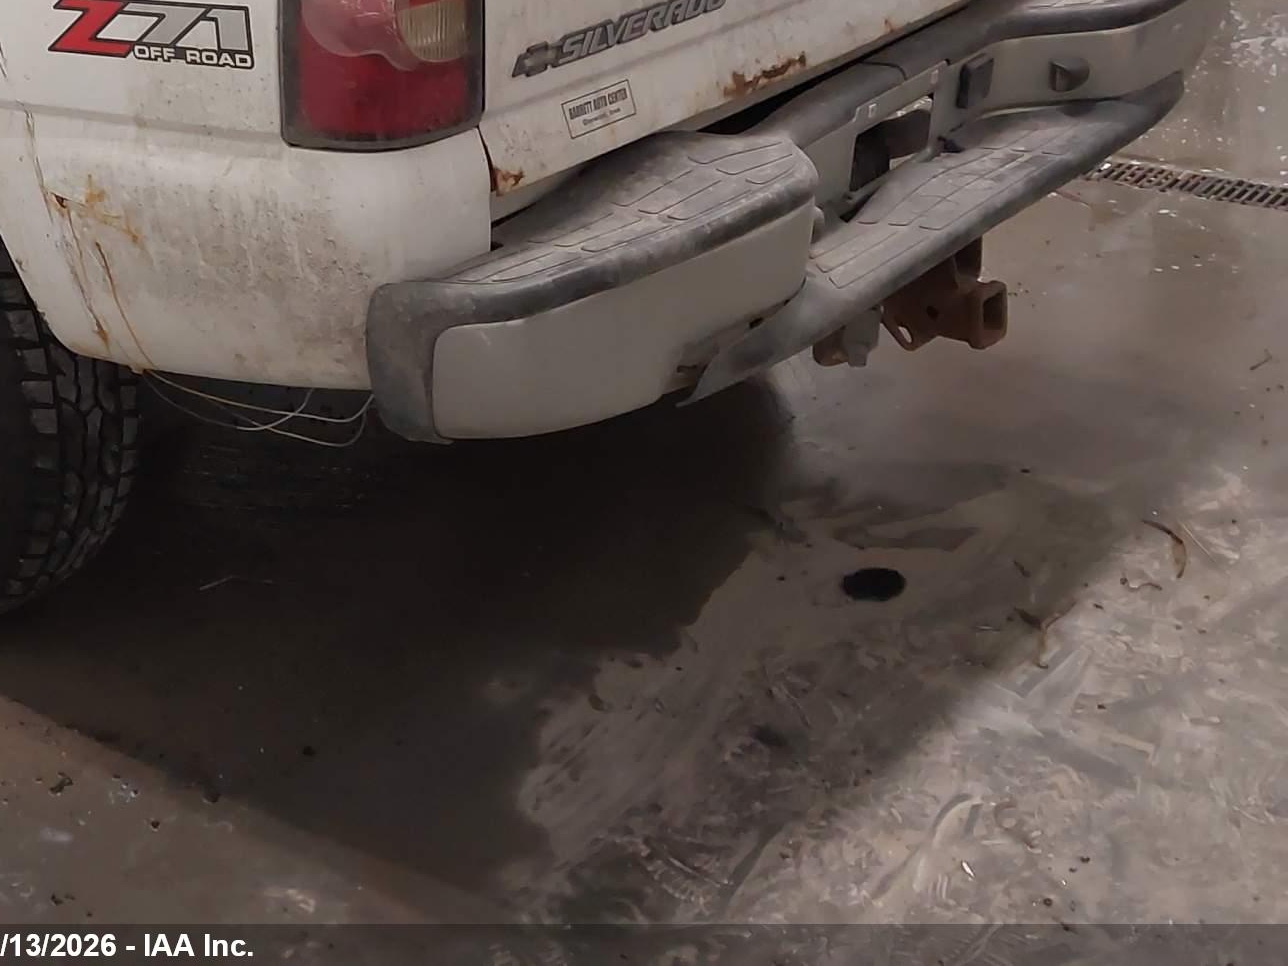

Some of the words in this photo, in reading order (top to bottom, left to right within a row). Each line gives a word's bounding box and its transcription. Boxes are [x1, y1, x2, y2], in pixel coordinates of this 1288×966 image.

[133, 45, 176, 62] OFF
[186, 50, 253, 69] ROAD
[593, 95, 607, 110] AUTO
